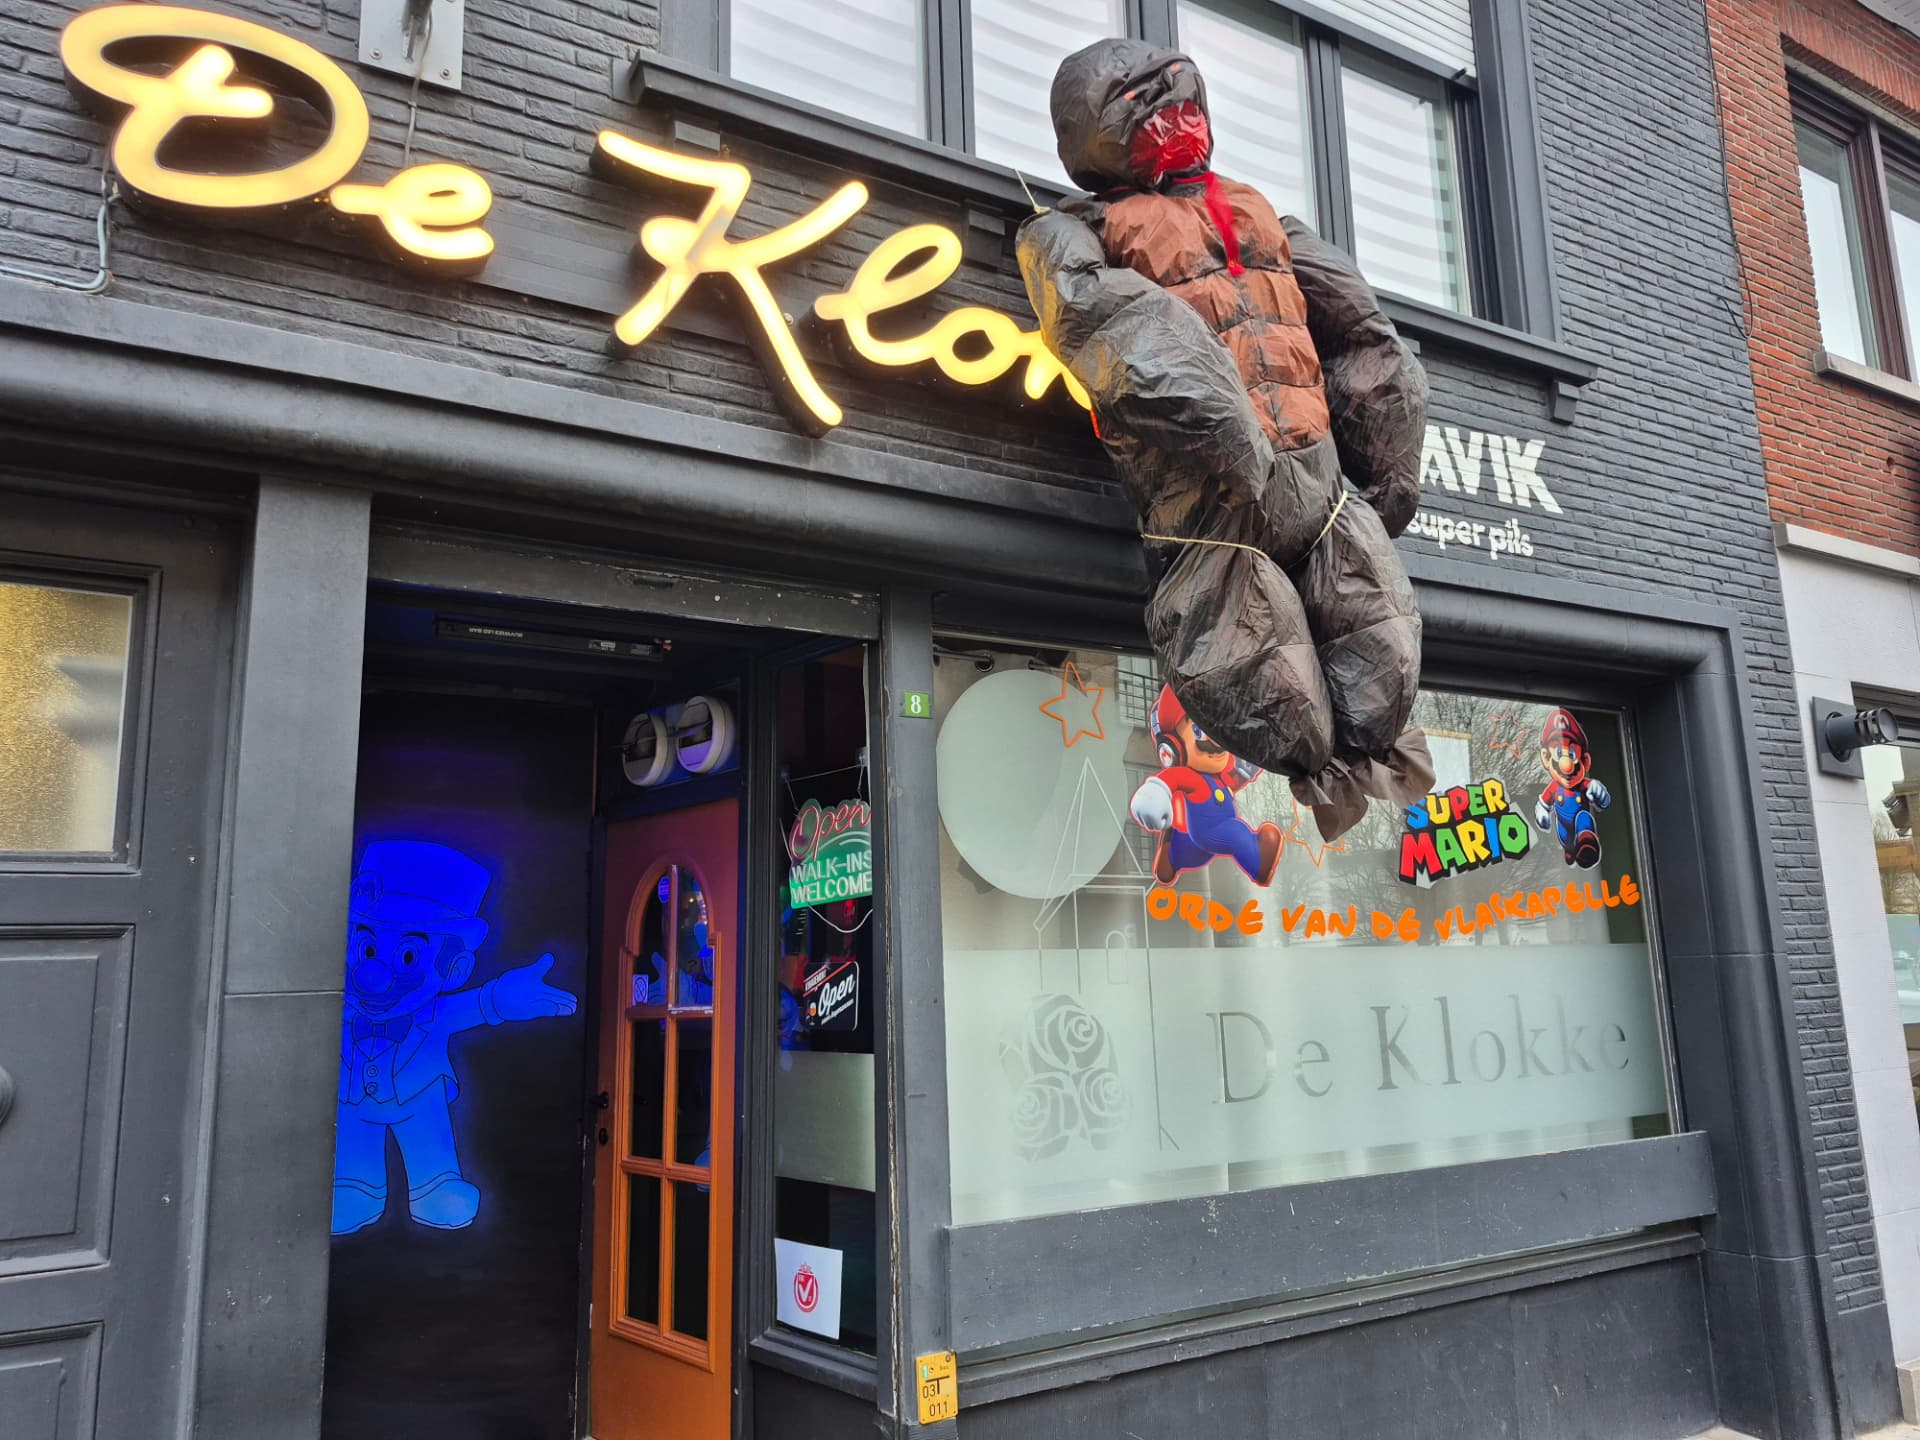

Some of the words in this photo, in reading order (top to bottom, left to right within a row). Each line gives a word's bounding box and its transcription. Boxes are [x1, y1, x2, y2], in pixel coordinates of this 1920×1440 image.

[60, 5, 493, 260] De
[1406, 510, 1486, 550] super
[1489, 517, 1534, 560] pils
[910, 695, 922, 714] 8
[1402, 778, 1510, 830] SUPER
[790, 805, 871, 862] Open
[1400, 813, 1530, 883] MARIO
[791, 850, 872, 884] WALK-INS
[791, 871, 872, 904] WELCOME
[1147, 887, 1264, 936] ORDE
[1281, 904, 1357, 939] VAN
[1371, 907, 1421, 942] DE
[1434, 874, 1640, 942] VLASKAPELLE
[817, 973, 856, 1017] Open
[1206, 1010, 1334, 1104] De
[1369, 992, 1631, 1091] Klokke
[929, 1401, 948, 1417] 011
